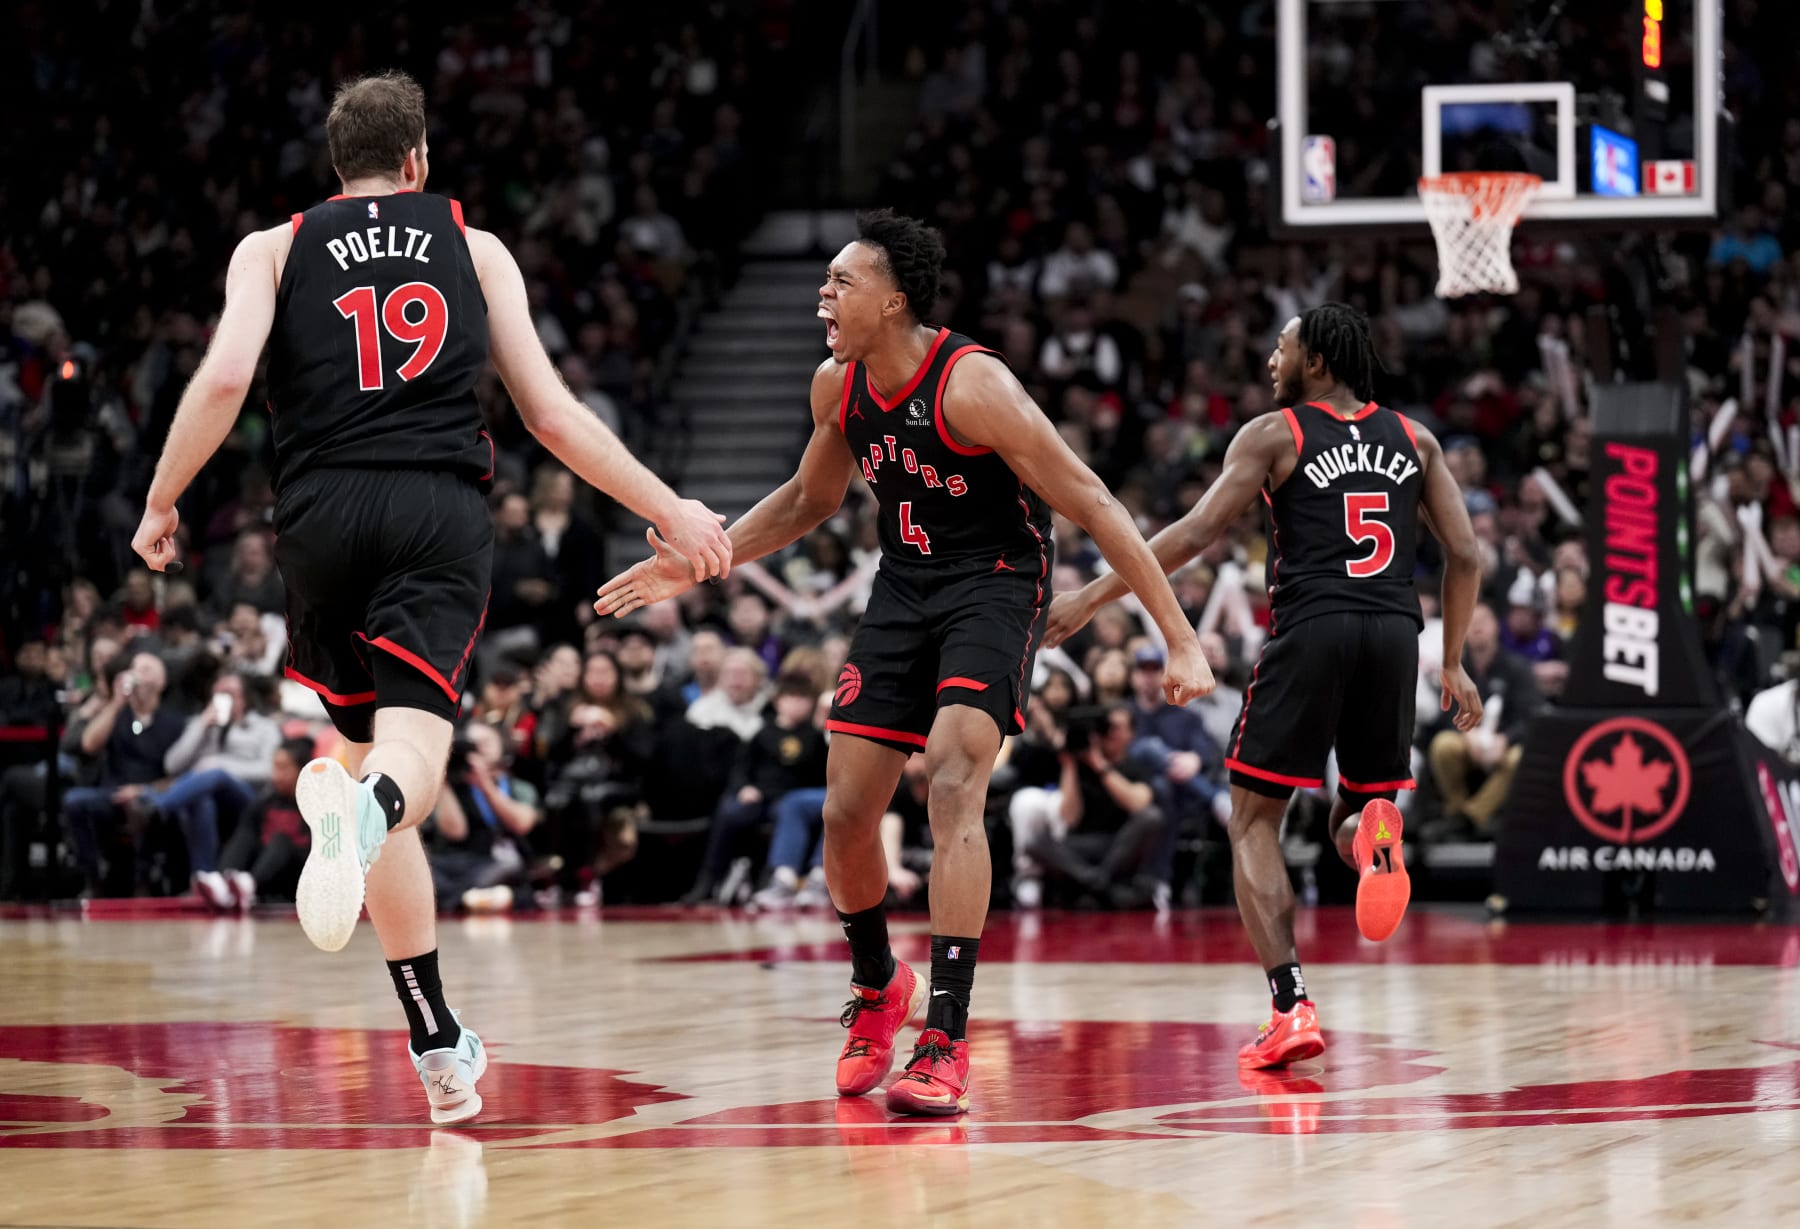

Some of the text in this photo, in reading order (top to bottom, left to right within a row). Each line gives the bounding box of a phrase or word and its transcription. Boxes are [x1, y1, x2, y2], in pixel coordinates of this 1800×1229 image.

[326, 226, 432, 271] POELTL
[333, 281, 448, 391] 19
[905, 418, 931, 426] Sun Life
[862, 435, 968, 497] APTORS
[1304, 443, 1418, 489] QUICKLEY
[899, 501, 931, 555] 4
[1343, 492, 1395, 578] 5
[1604, 442, 1659, 697] POINTSBET
[1538, 846, 1716, 871] AIR CANADA
